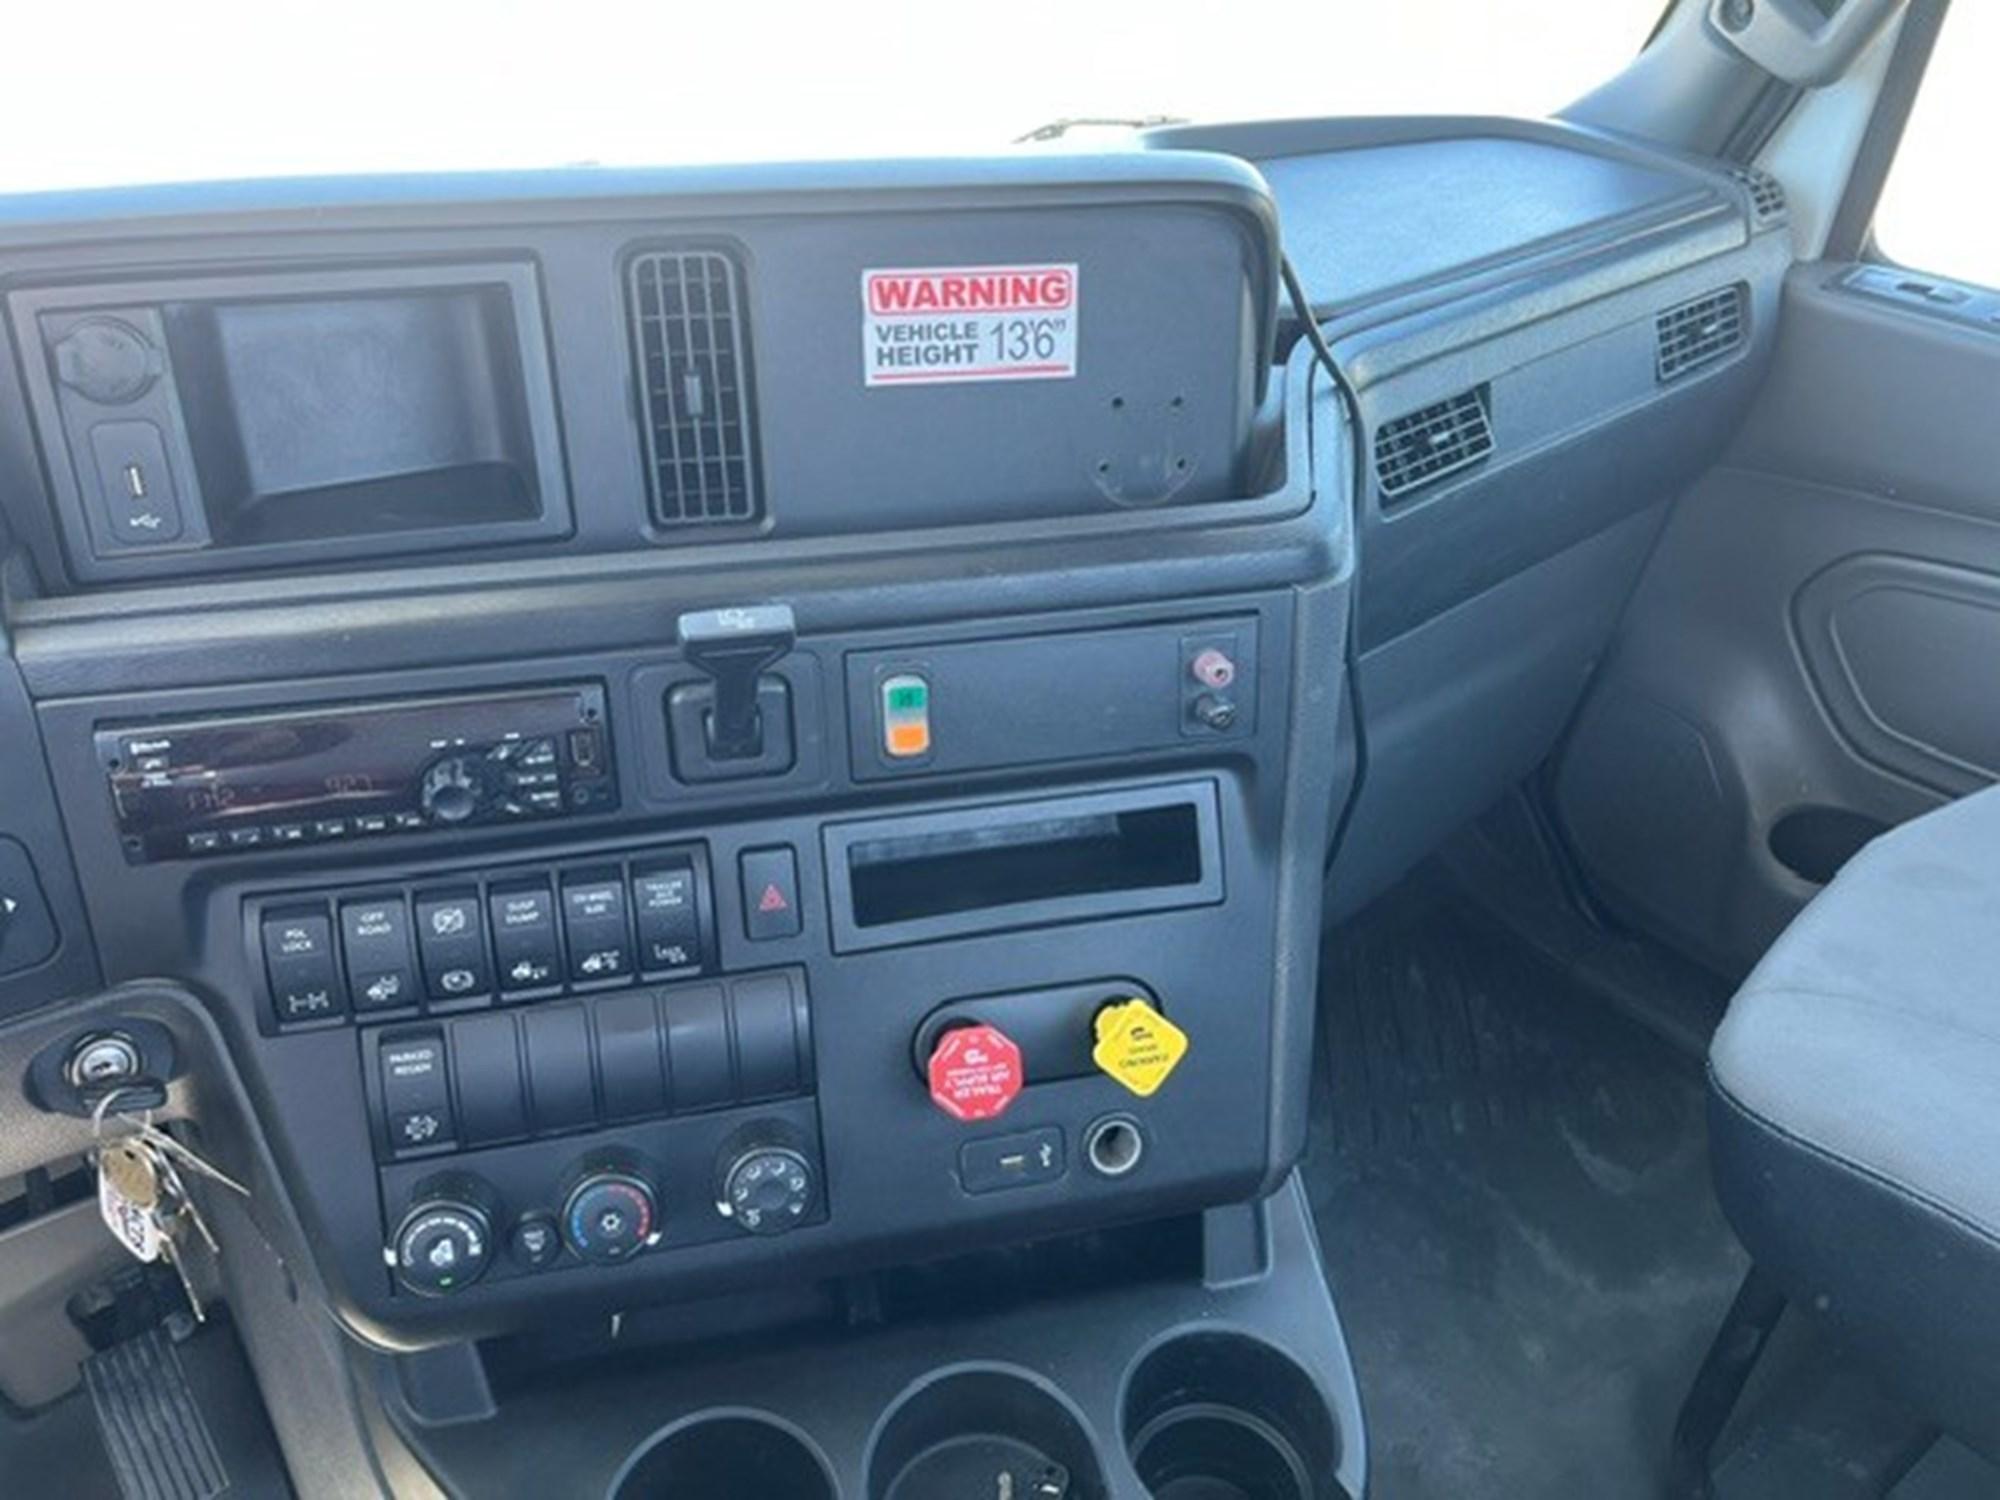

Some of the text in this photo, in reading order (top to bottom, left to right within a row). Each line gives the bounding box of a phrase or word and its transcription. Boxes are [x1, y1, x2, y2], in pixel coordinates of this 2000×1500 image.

[875, 277, 1067, 309] WARNING
[876, 321, 979, 343] VEHICLE
[876, 344, 979, 366] HEIGHT
[360, 911, 385, 923] OFF
[357, 922, 391, 936] ROAD
[282, 940, 312, 952] LOCK
[389, 1049, 433, 1063] PARKED
[394, 1062, 432, 1075] REGEN
